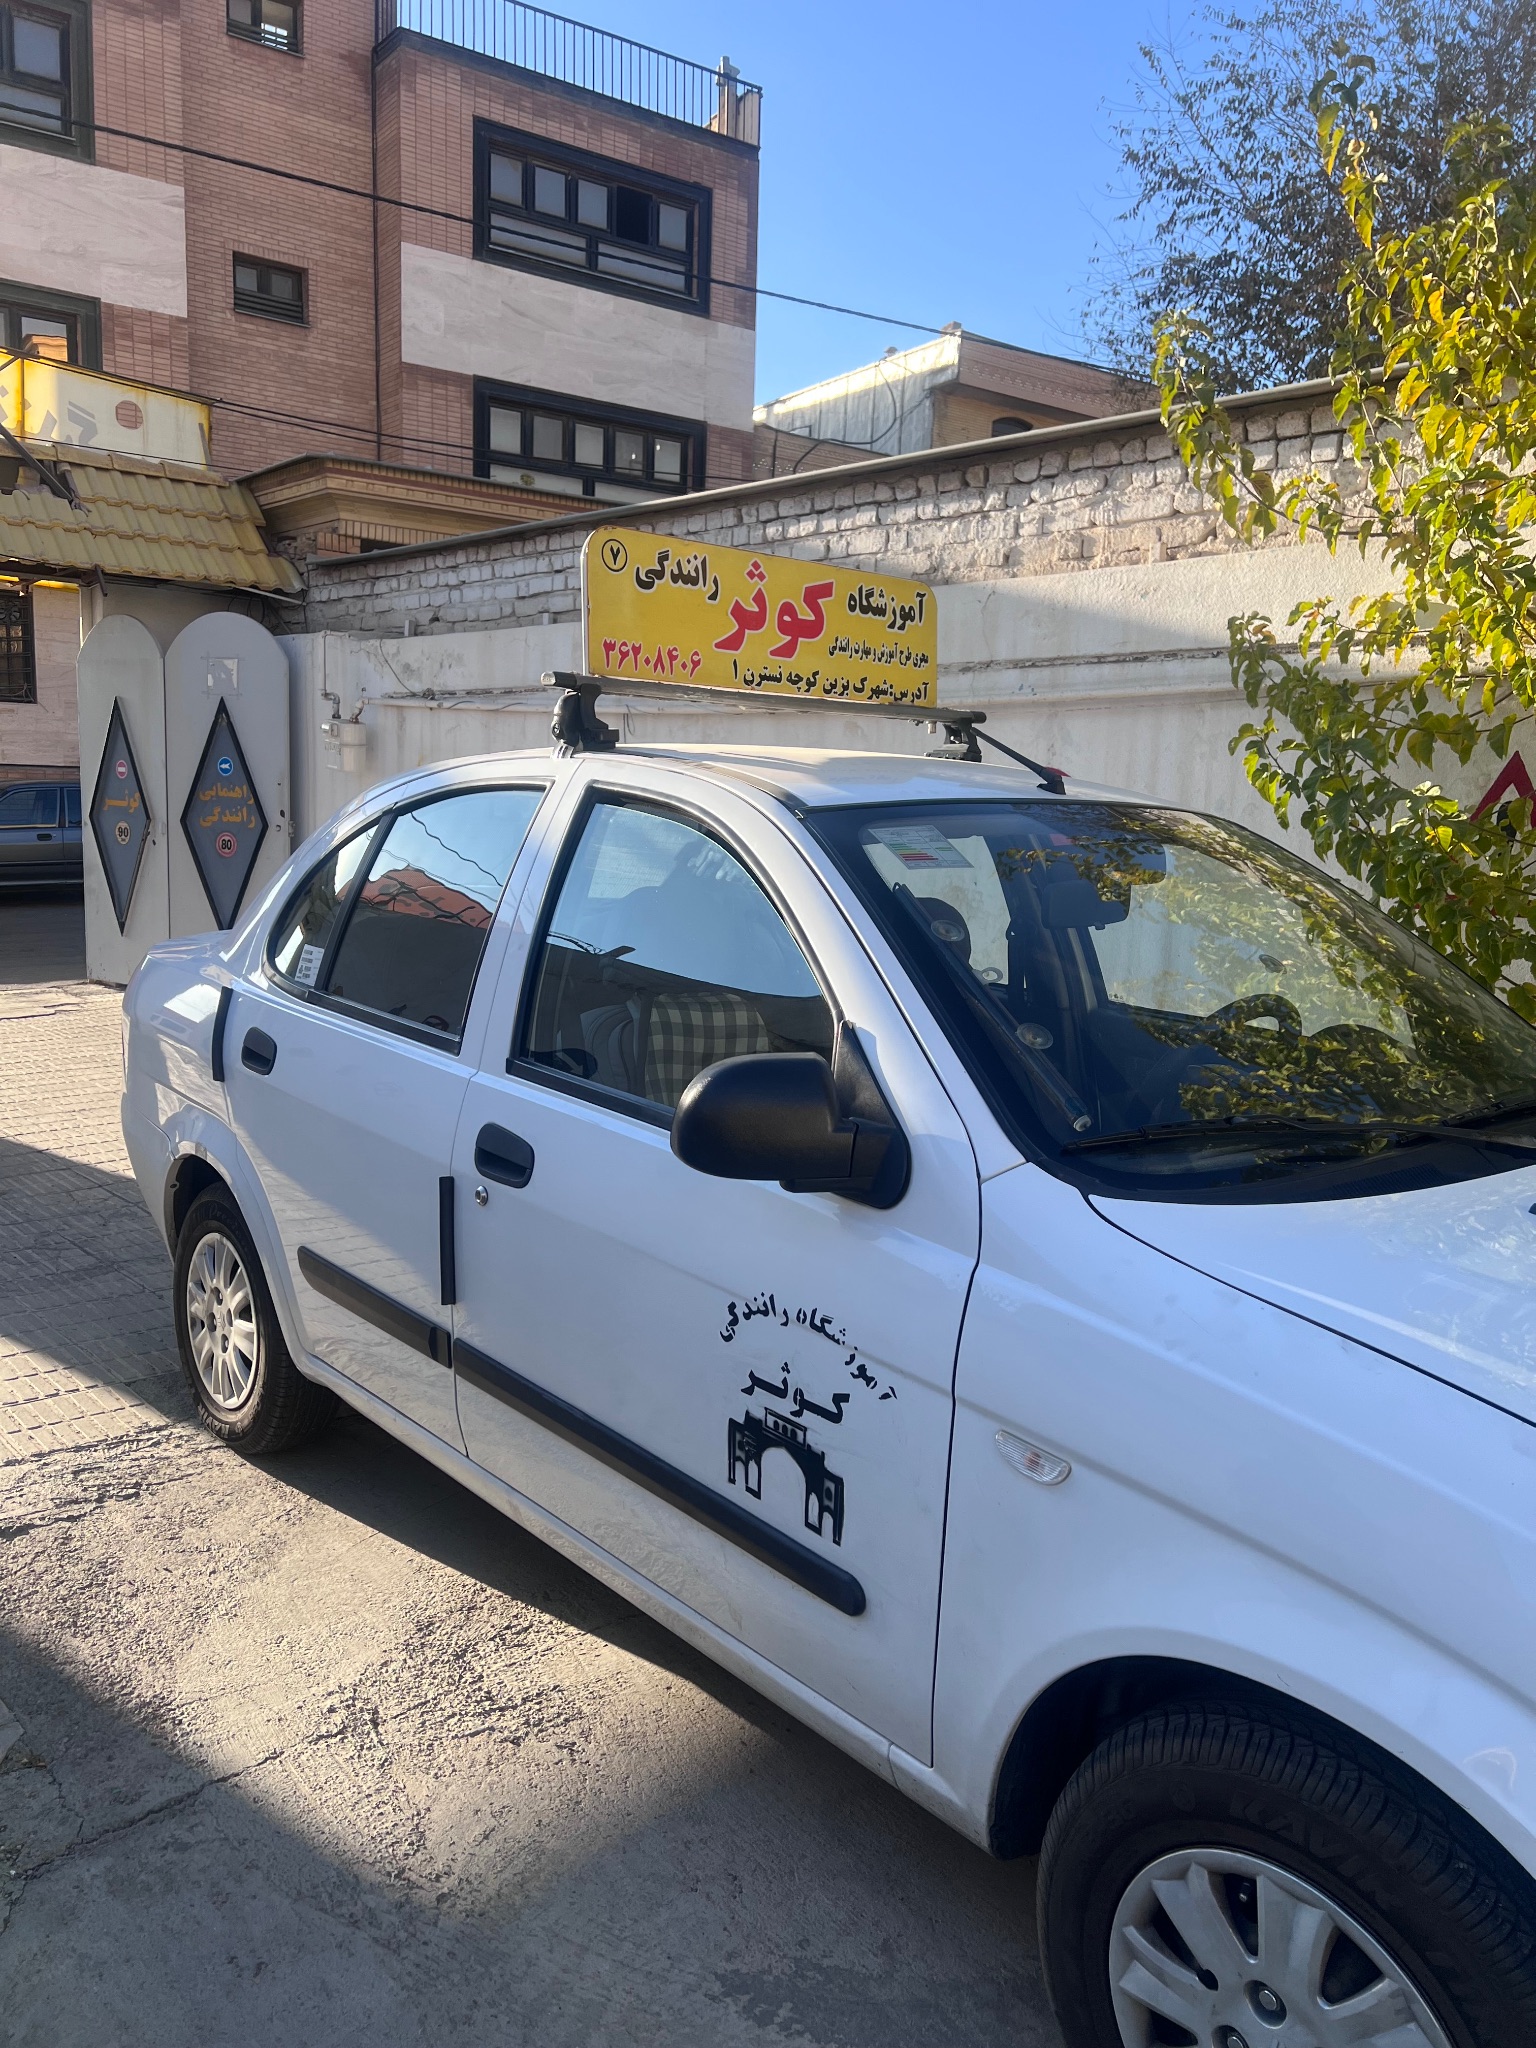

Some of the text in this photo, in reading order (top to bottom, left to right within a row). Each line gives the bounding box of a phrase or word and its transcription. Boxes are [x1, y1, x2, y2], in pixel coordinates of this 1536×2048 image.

[635, 549, 927, 659] آموزشگاه کوثر رانندگی
[602, 638, 702, 679] ۳۶۲۰۸۴۰۶
[828, 635, 853, 659] رانندگی
[877, 641, 898, 665] آموزش
[743, 665, 783, 687] نسترن
[785, 670, 819, 693] کوچه
[117, 826, 129, 838] 90
[221, 838, 232, 851] 80
[740, 1361, 851, 1424] کوثر
